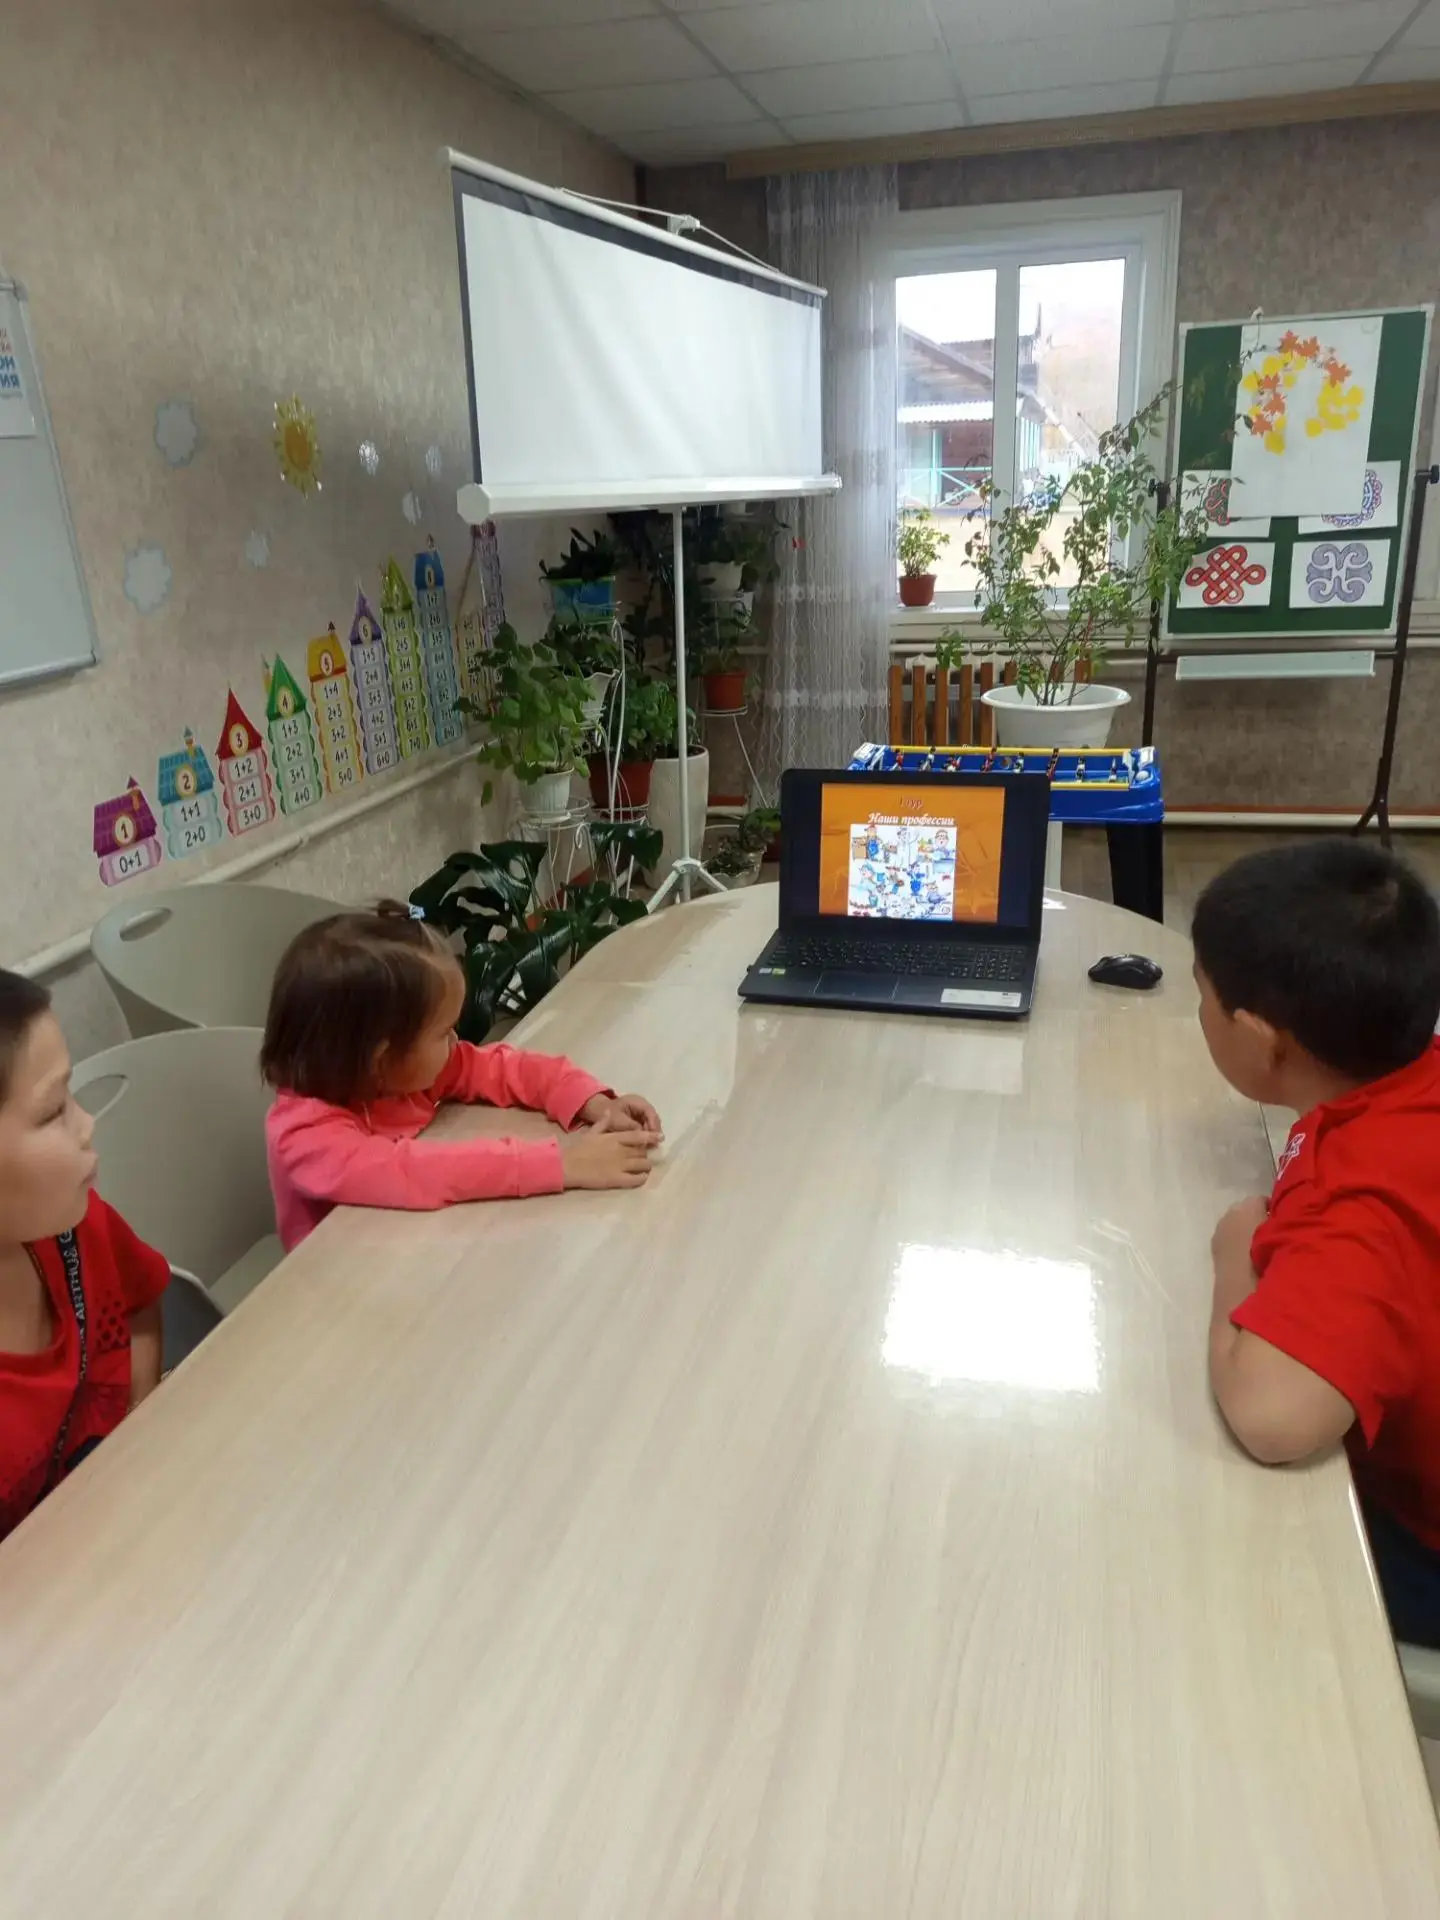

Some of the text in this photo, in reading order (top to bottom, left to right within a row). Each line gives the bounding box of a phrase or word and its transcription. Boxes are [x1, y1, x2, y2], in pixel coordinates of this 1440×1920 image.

[394, 616, 405, 631] 1+6
[429, 612, 441, 627] 2+6
[363, 623, 368, 637] 6
[431, 631, 443, 646] 3+5
[396, 636, 408, 652] 2+5
[324, 655, 330, 672] 5
[362, 647, 375, 664] 1+5
[400, 656, 411, 673] 3+4
[365, 668, 378, 686] 2+4
[401, 677, 413, 693] 4+3
[323, 681, 338, 699] 1+4
[368, 688, 382, 707] 3+3
[282, 694, 288, 709] 4
[327, 703, 342, 721] 2+3
[371, 709, 385, 725] 4+2
[282, 719, 299, 739] 1+3
[331, 725, 346, 742] 3+2
[406, 717, 418, 733] 6+1
[234, 732, 243, 748] 3
[373, 730, 387, 747] 5+1
[409, 736, 421, 751] 7+0
[285, 742, 303, 762] 2+2
[335, 747, 349, 763] 4+1
[376, 750, 390, 768] 6+0
[234, 758, 254, 778] 1+2
[289, 765, 306, 784] 3+1
[338, 767, 353, 785] 5+0
[183, 774, 191, 790] 2
[238, 781, 257, 802] 2+1
[294, 785, 310, 804] 4+0
[180, 803, 201, 822] 1+1
[243, 805, 262, 826] 3+0
[868, 812, 956, 827] Наши профессии
[121, 823, 129, 839] 1
[184, 826, 207, 849] 2+0
[119, 850, 143, 875] 0+1
